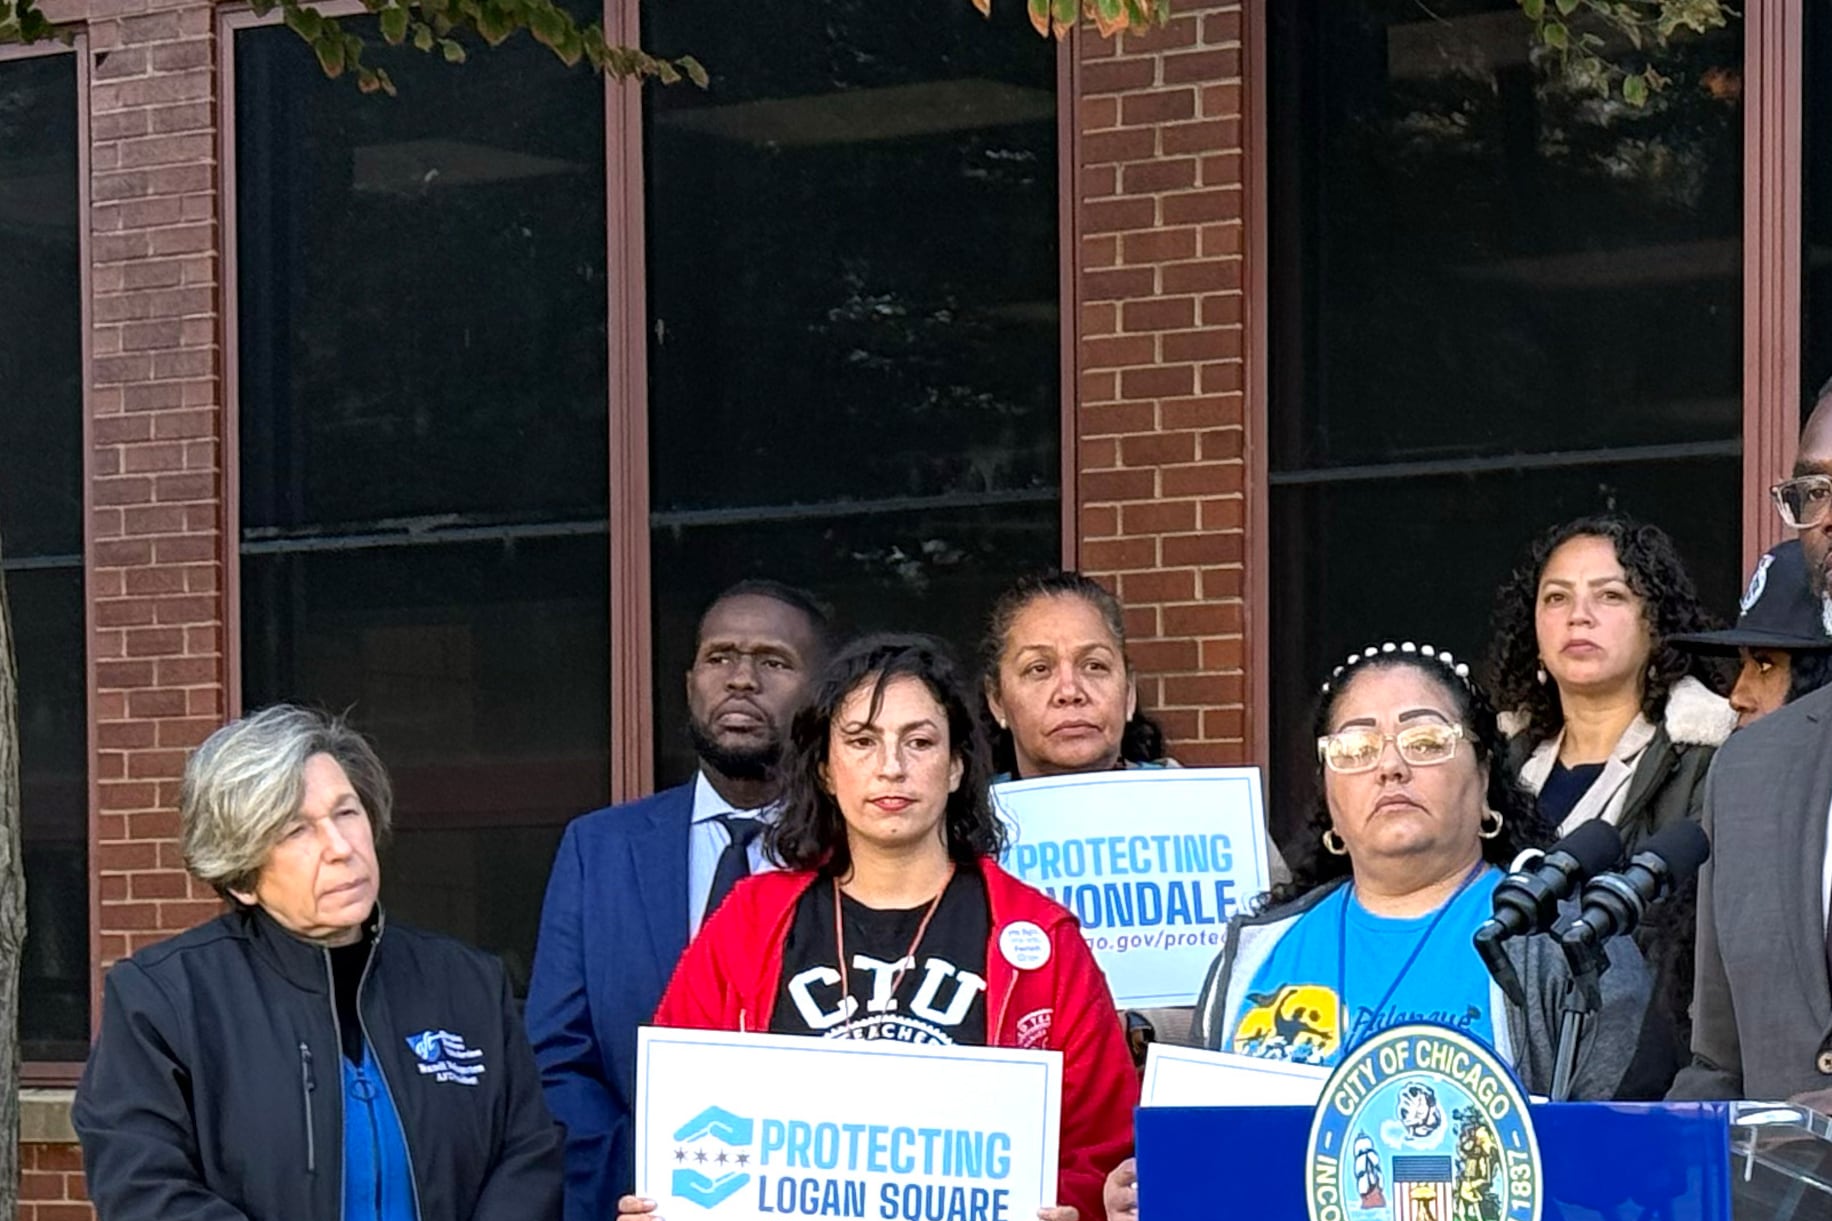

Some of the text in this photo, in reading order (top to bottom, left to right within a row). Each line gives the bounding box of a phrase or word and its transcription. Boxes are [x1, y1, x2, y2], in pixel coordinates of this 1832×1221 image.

[1016, 834, 1233, 880] PROTECTING
[788, 953, 987, 1029] CTU
[1334, 1040, 1510, 1119] CITY OF CHICAGO
[760, 1119, 1011, 1179] PROTECTING
[758, 1175, 866, 1218] LOGAN
[1510, 1152, 1532, 1211] 1837
